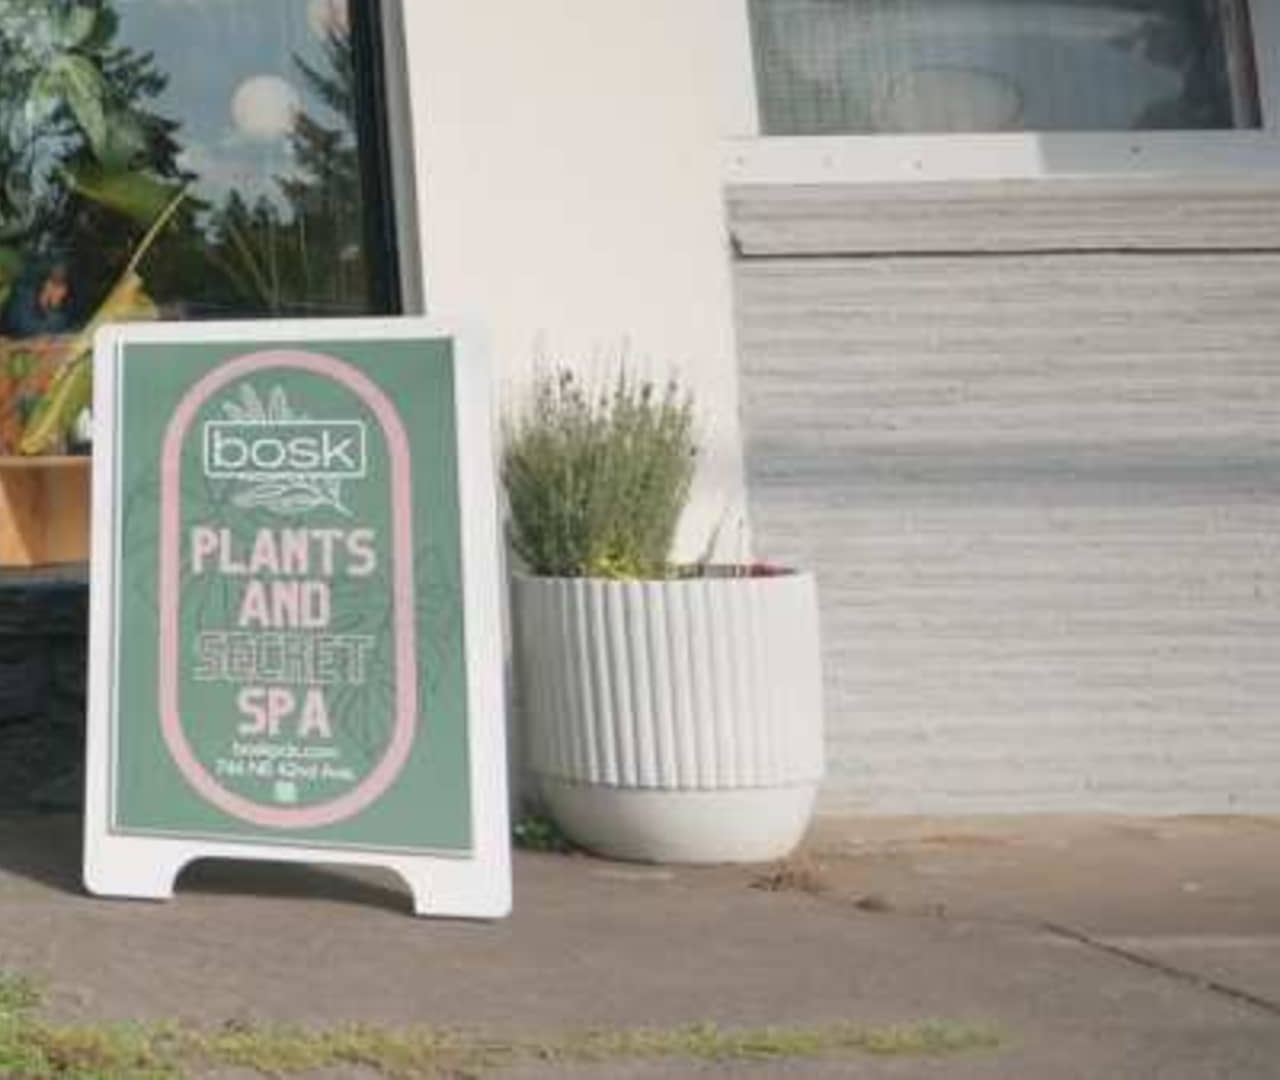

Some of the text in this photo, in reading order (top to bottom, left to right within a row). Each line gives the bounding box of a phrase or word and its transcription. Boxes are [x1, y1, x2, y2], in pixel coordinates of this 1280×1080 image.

[213, 430, 355, 469] bosk
[192, 527, 376, 576] PLANTS
[239, 580, 330, 627] AND
[192, 631, 376, 685] SECRET
[237, 687, 332, 738] SPA
